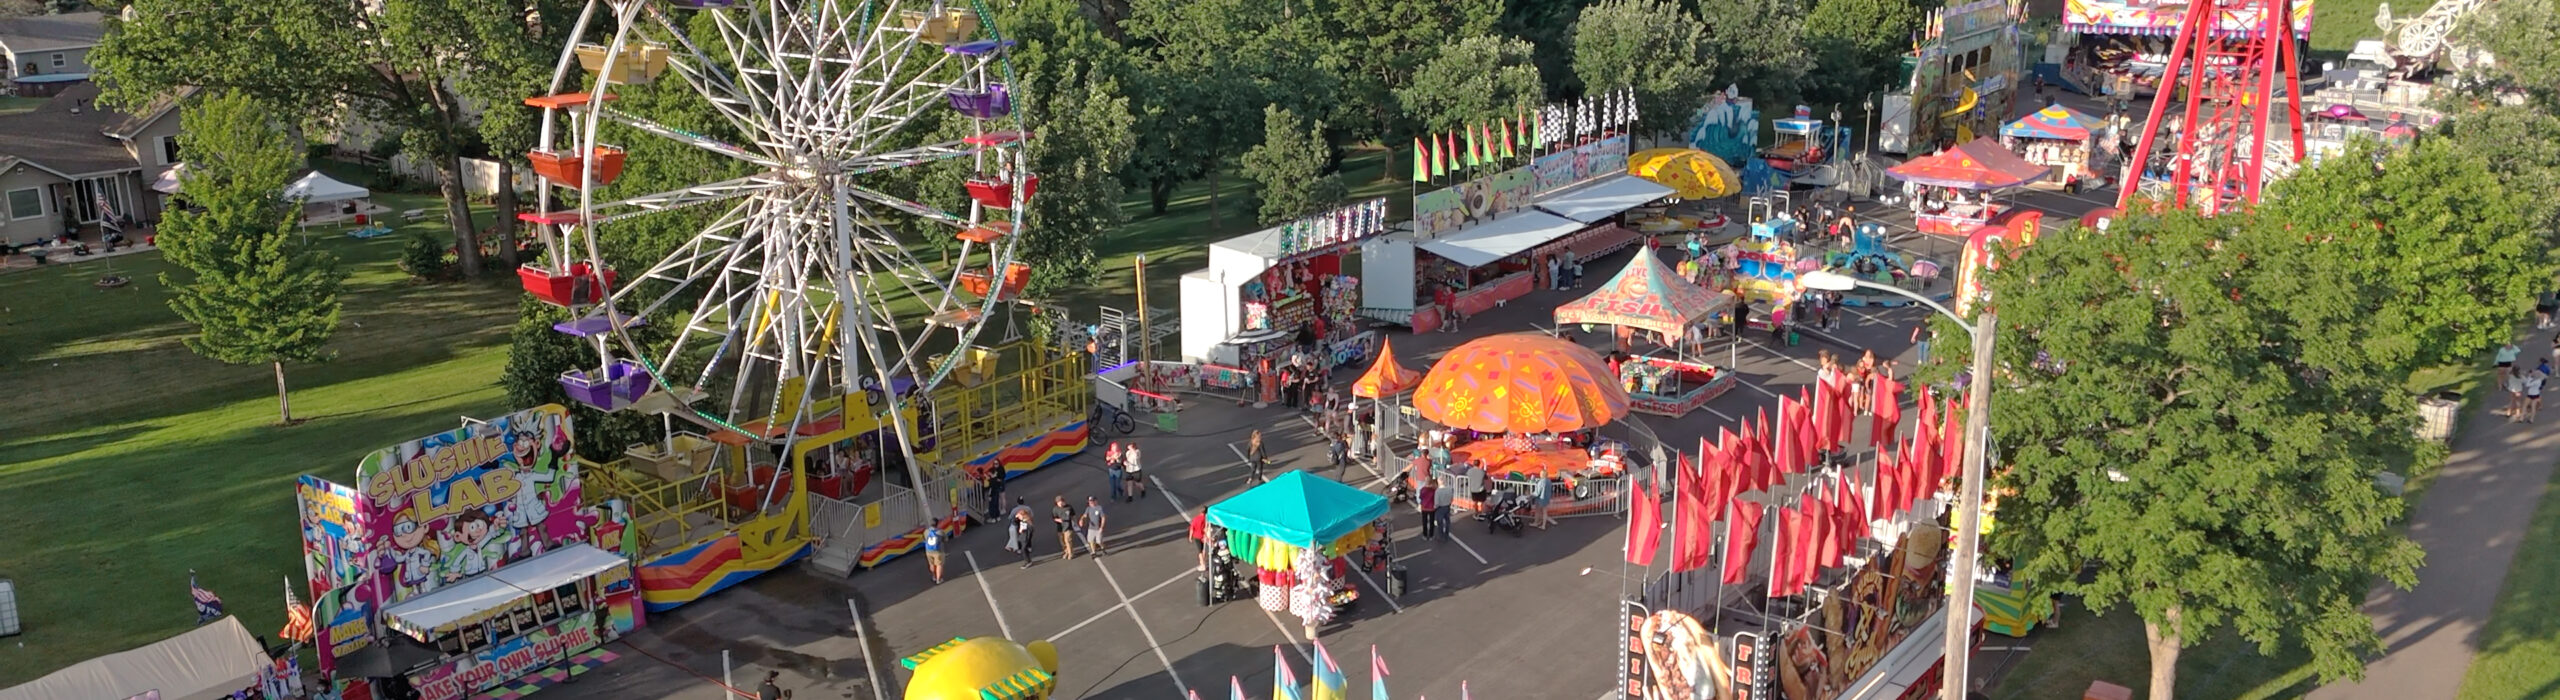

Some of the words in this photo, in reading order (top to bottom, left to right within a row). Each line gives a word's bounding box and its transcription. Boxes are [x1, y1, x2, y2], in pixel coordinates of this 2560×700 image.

[1586, 297, 1663, 316] FISH
[368, 434, 509, 508] SLUSHIE
[411, 467, 522, 526] LAB
[330, 616, 368, 645] MAKE
[454, 662, 498, 695] YOUR
[501, 649, 535, 676] OWN
[533, 625, 591, 660] SLUSHIE
